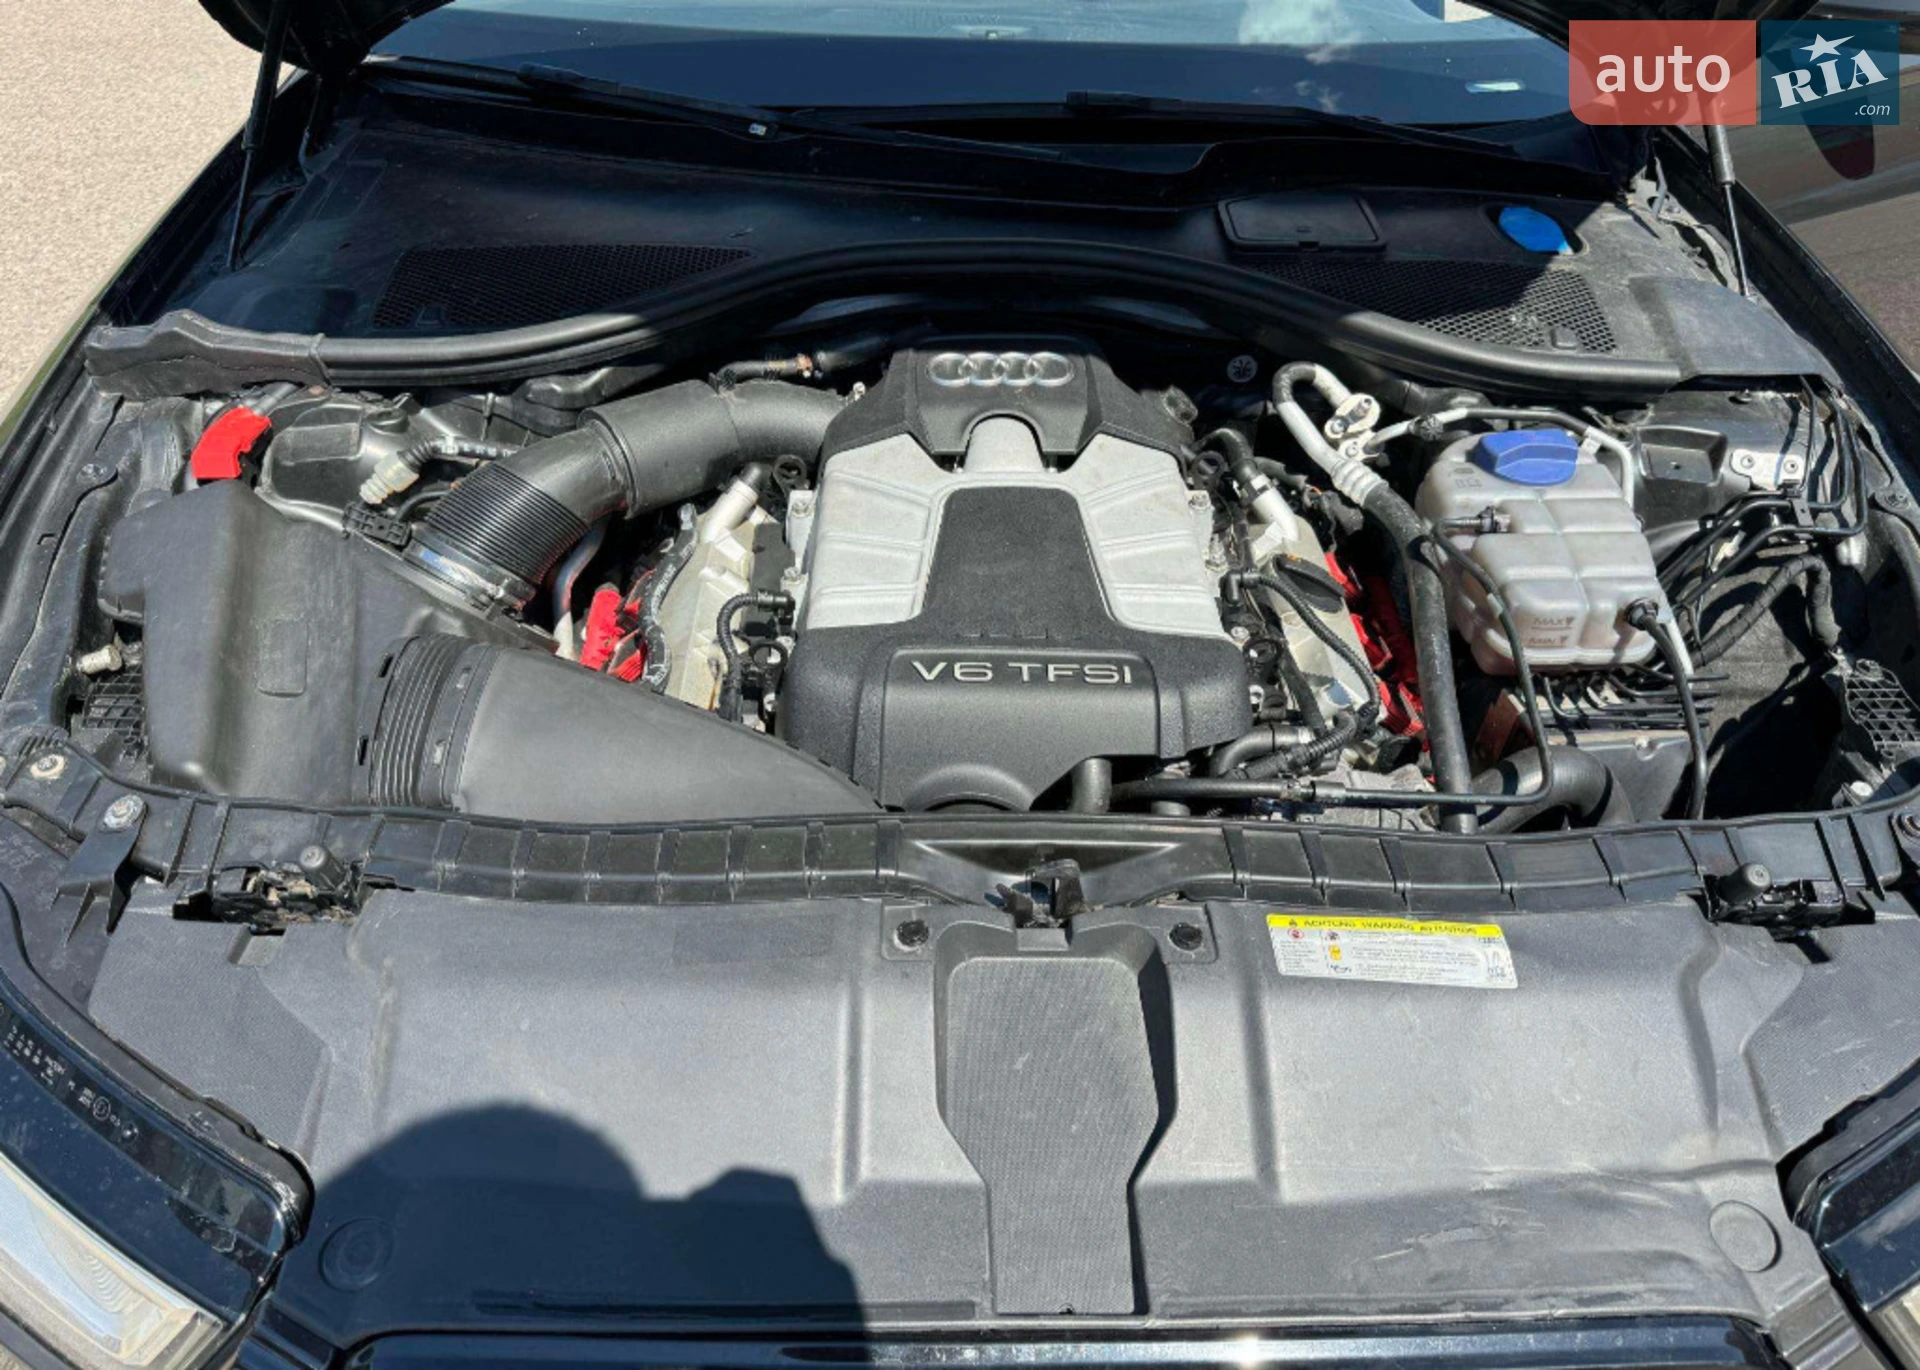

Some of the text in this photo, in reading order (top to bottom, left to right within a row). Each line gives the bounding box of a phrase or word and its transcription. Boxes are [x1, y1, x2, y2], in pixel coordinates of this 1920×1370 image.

[1533, 617, 1564, 626] MAX
[912, 660, 1133, 684] V6 TFSI
[1303, 918, 1357, 928] ACHTUNG
